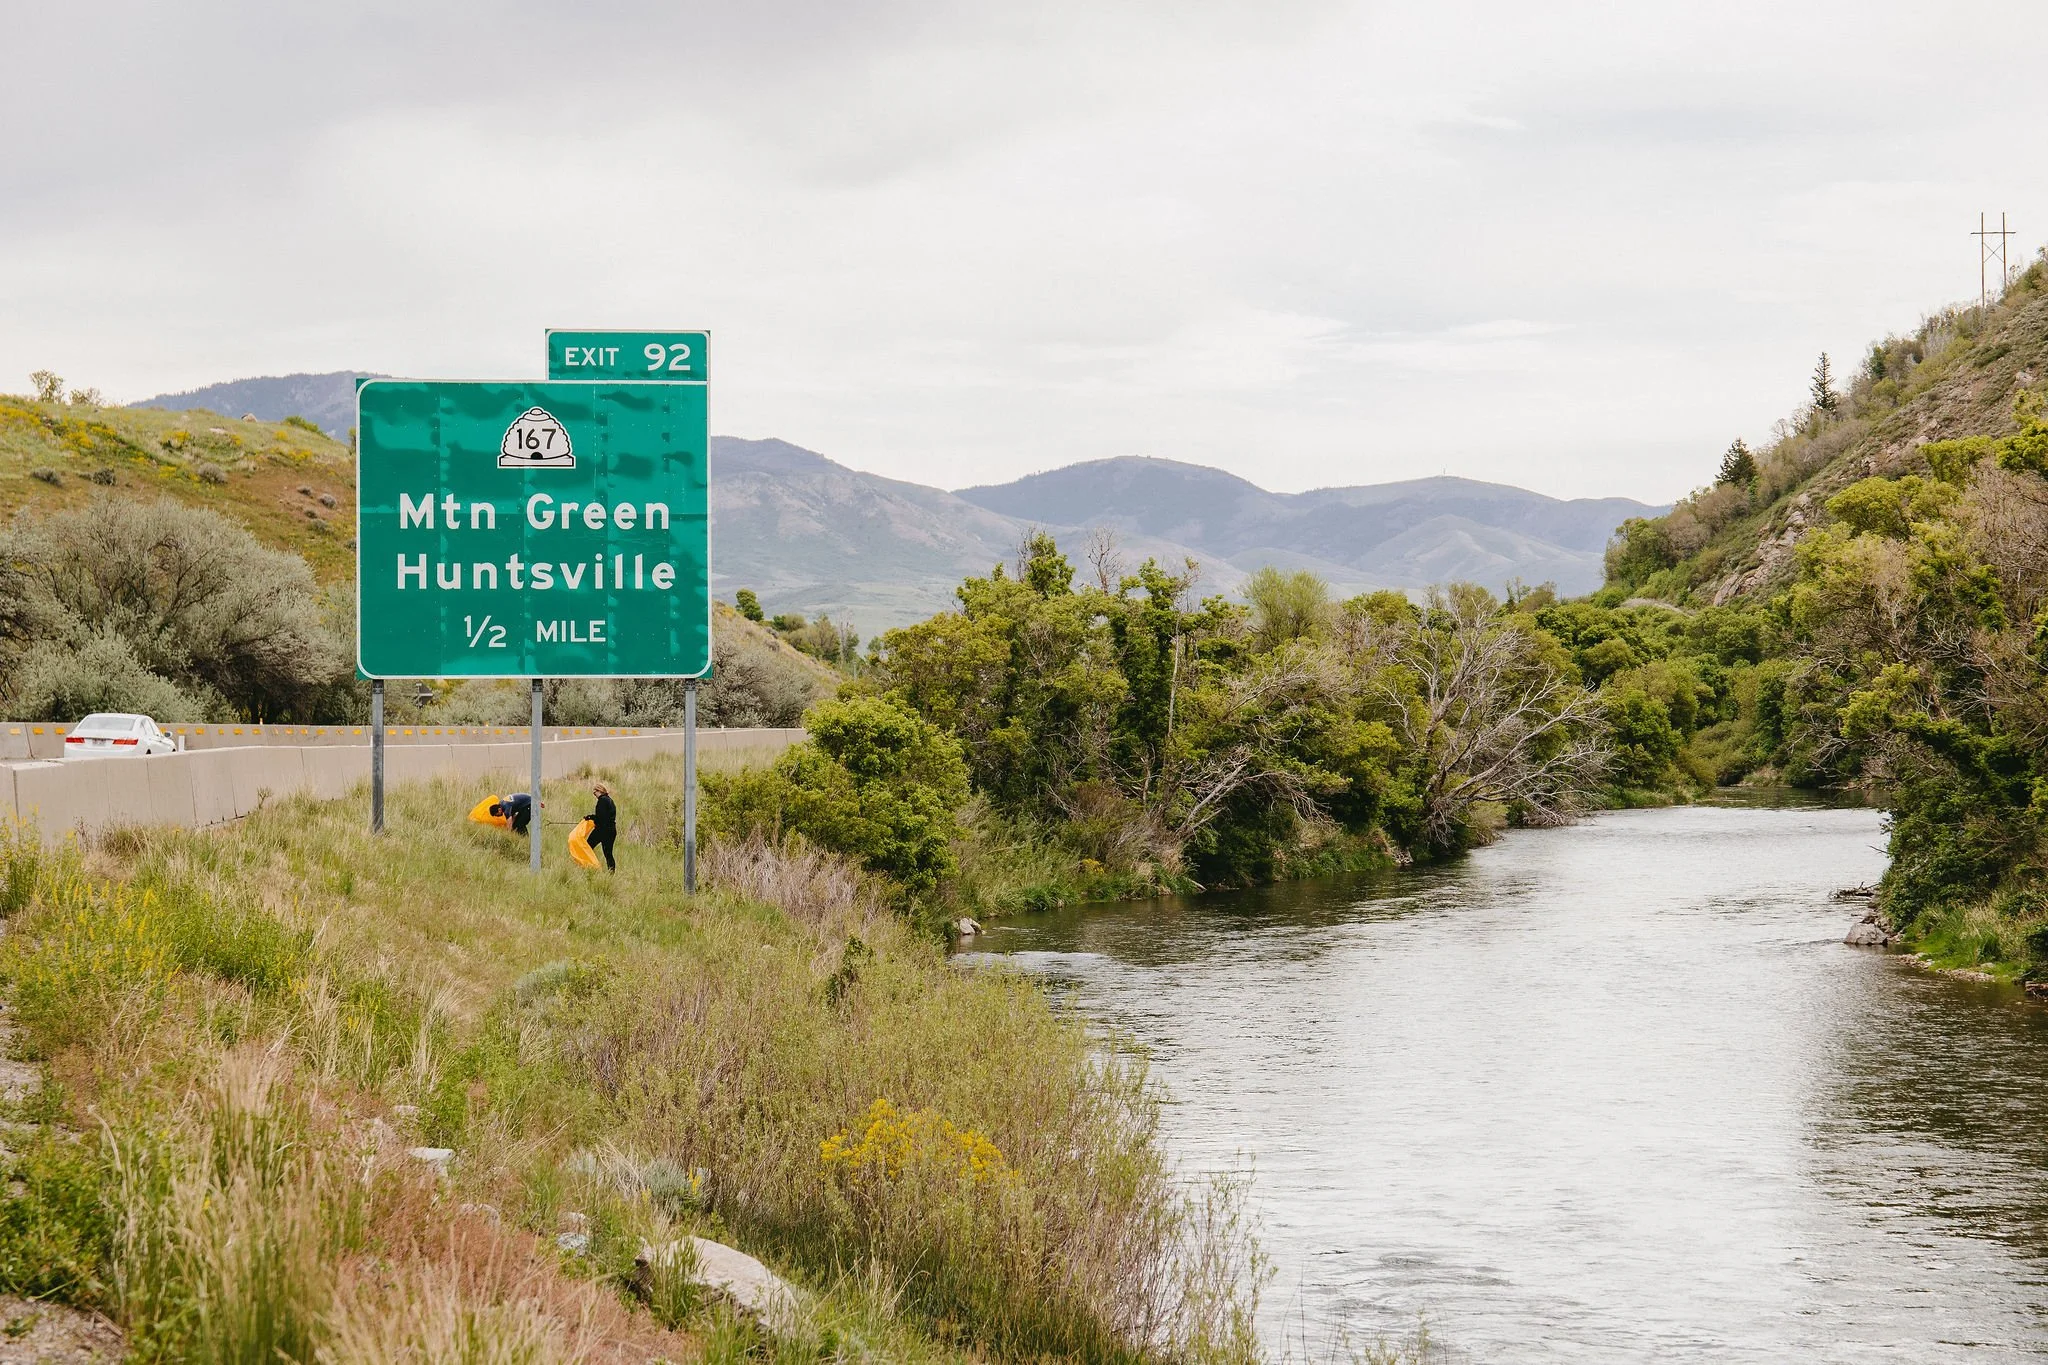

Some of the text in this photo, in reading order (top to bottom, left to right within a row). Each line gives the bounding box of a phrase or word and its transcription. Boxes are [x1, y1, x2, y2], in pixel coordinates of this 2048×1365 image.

[565, 343, 691, 371] EXIT 92
[516, 428, 557, 450] 167
[399, 493, 670, 530] Mtn Green
[397, 553, 676, 590] Huntsville
[536, 620, 607, 642] MILE
